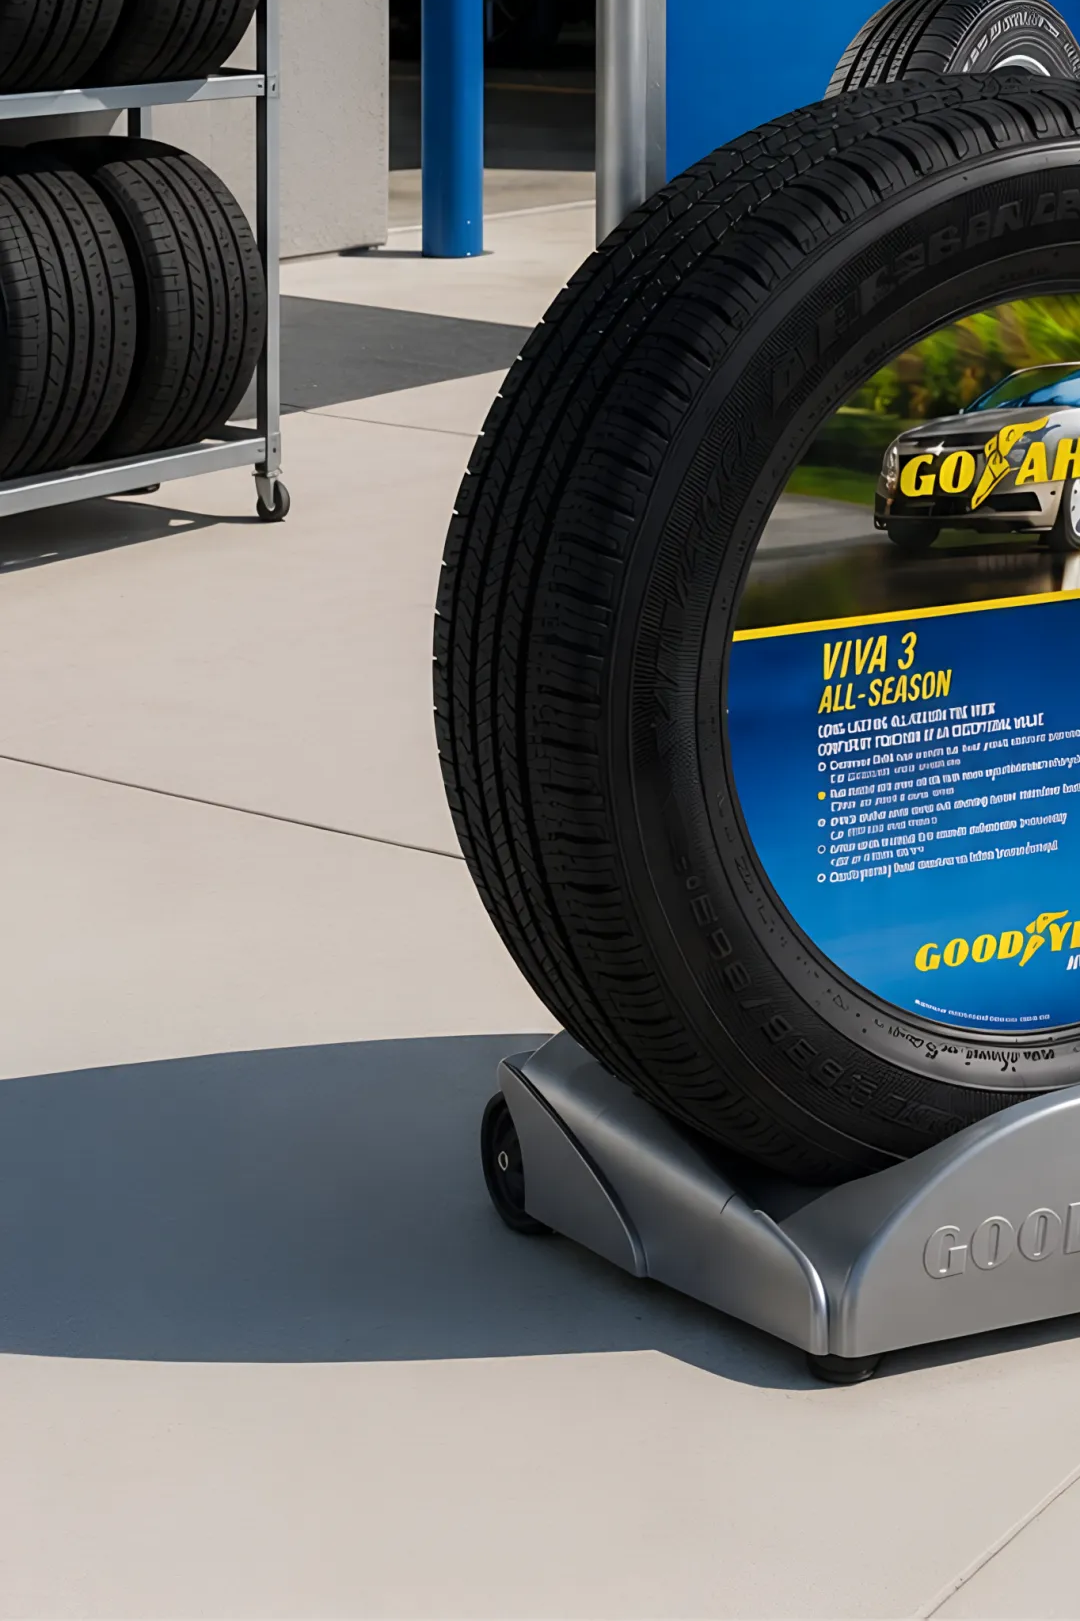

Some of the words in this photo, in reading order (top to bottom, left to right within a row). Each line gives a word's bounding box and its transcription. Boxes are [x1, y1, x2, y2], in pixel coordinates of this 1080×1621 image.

[900, 450, 976, 497] GO
[823, 635, 888, 680] VIVA
[897, 631, 917, 670] 3
[818, 669, 952, 714] ALL-SEASON
